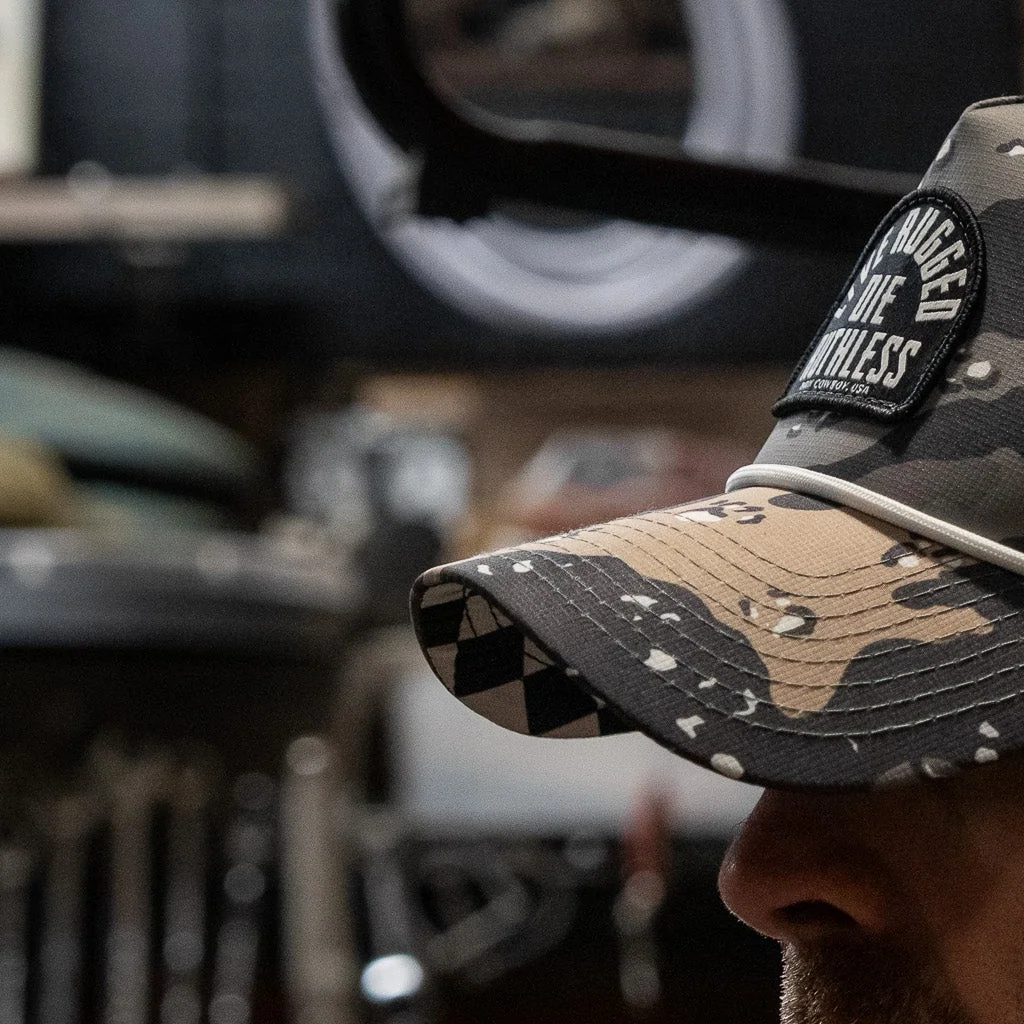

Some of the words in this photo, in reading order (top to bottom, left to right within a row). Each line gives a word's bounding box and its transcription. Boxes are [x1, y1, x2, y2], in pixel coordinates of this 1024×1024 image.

[890, 206, 968, 322] RUGGED
[848, 274, 906, 325] DIE
[850, 383, 870, 394] USA
